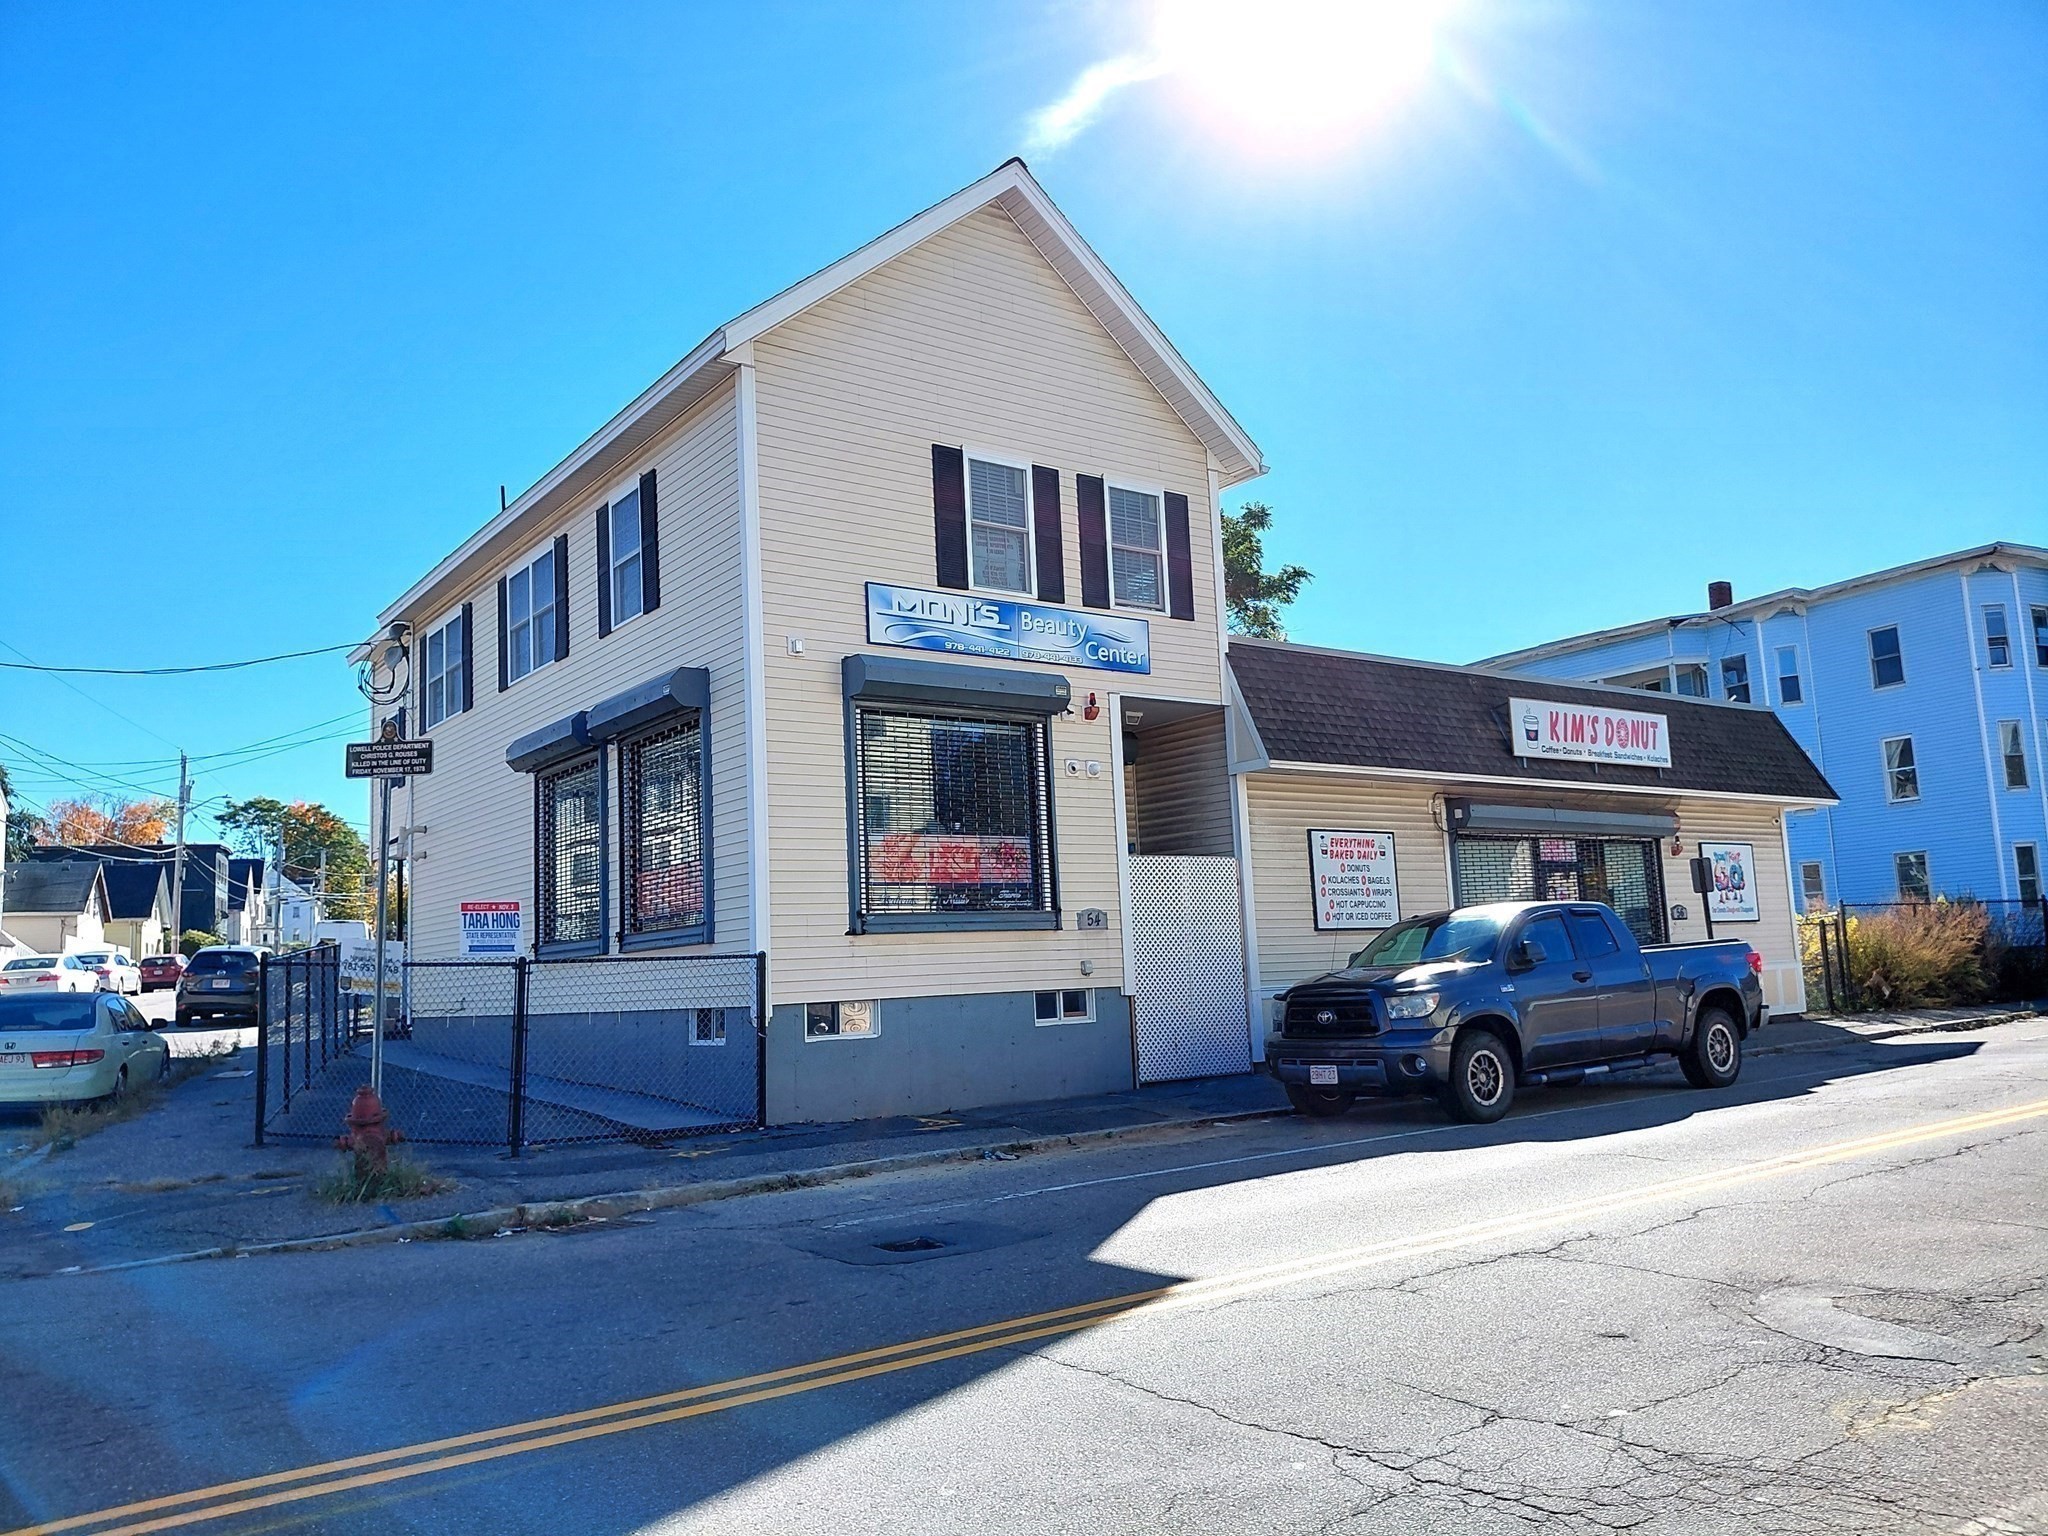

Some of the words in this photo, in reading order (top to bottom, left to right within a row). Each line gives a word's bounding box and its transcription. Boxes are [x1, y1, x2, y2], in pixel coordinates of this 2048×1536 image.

[1021, 611, 1089, 648] Beauty
[944, 641, 1011, 656] 978-441-4122
[1085, 641, 1146, 666] Center
[1549, 710, 1599, 745] KIM'S
[1604, 716, 1659, 750] DONUT
[1541, 745, 1560, 754] Coffee
[1563, 747, 1582, 756] Donuts
[1587, 749, 1613, 759] Breakfast
[1614, 751, 1643, 761] Sandwiches
[1647, 754, 1669, 763] Kolaches
[1329, 838, 1376, 849] EVERYTHING
[1329, 850, 1354, 860] BAKED
[1356, 850, 1379, 860] DAILY
[1346, 864, 1371, 872] DONUTS
[1327, 876, 1360, 884] KOLACHES
[1327, 888, 1365, 896] CROSSIANTS
[1349, 900, 1387, 908] CAPPUCCINO
[461, 912, 490, 929] TARA
[491, 912, 520, 929] HONG
[1087, 911, 1101, 927] 54
[1345, 913, 1354, 921] OR
[1370, 912, 1393, 920] COFFEE
[480, 931, 516, 939] REPRESENTATIVE
